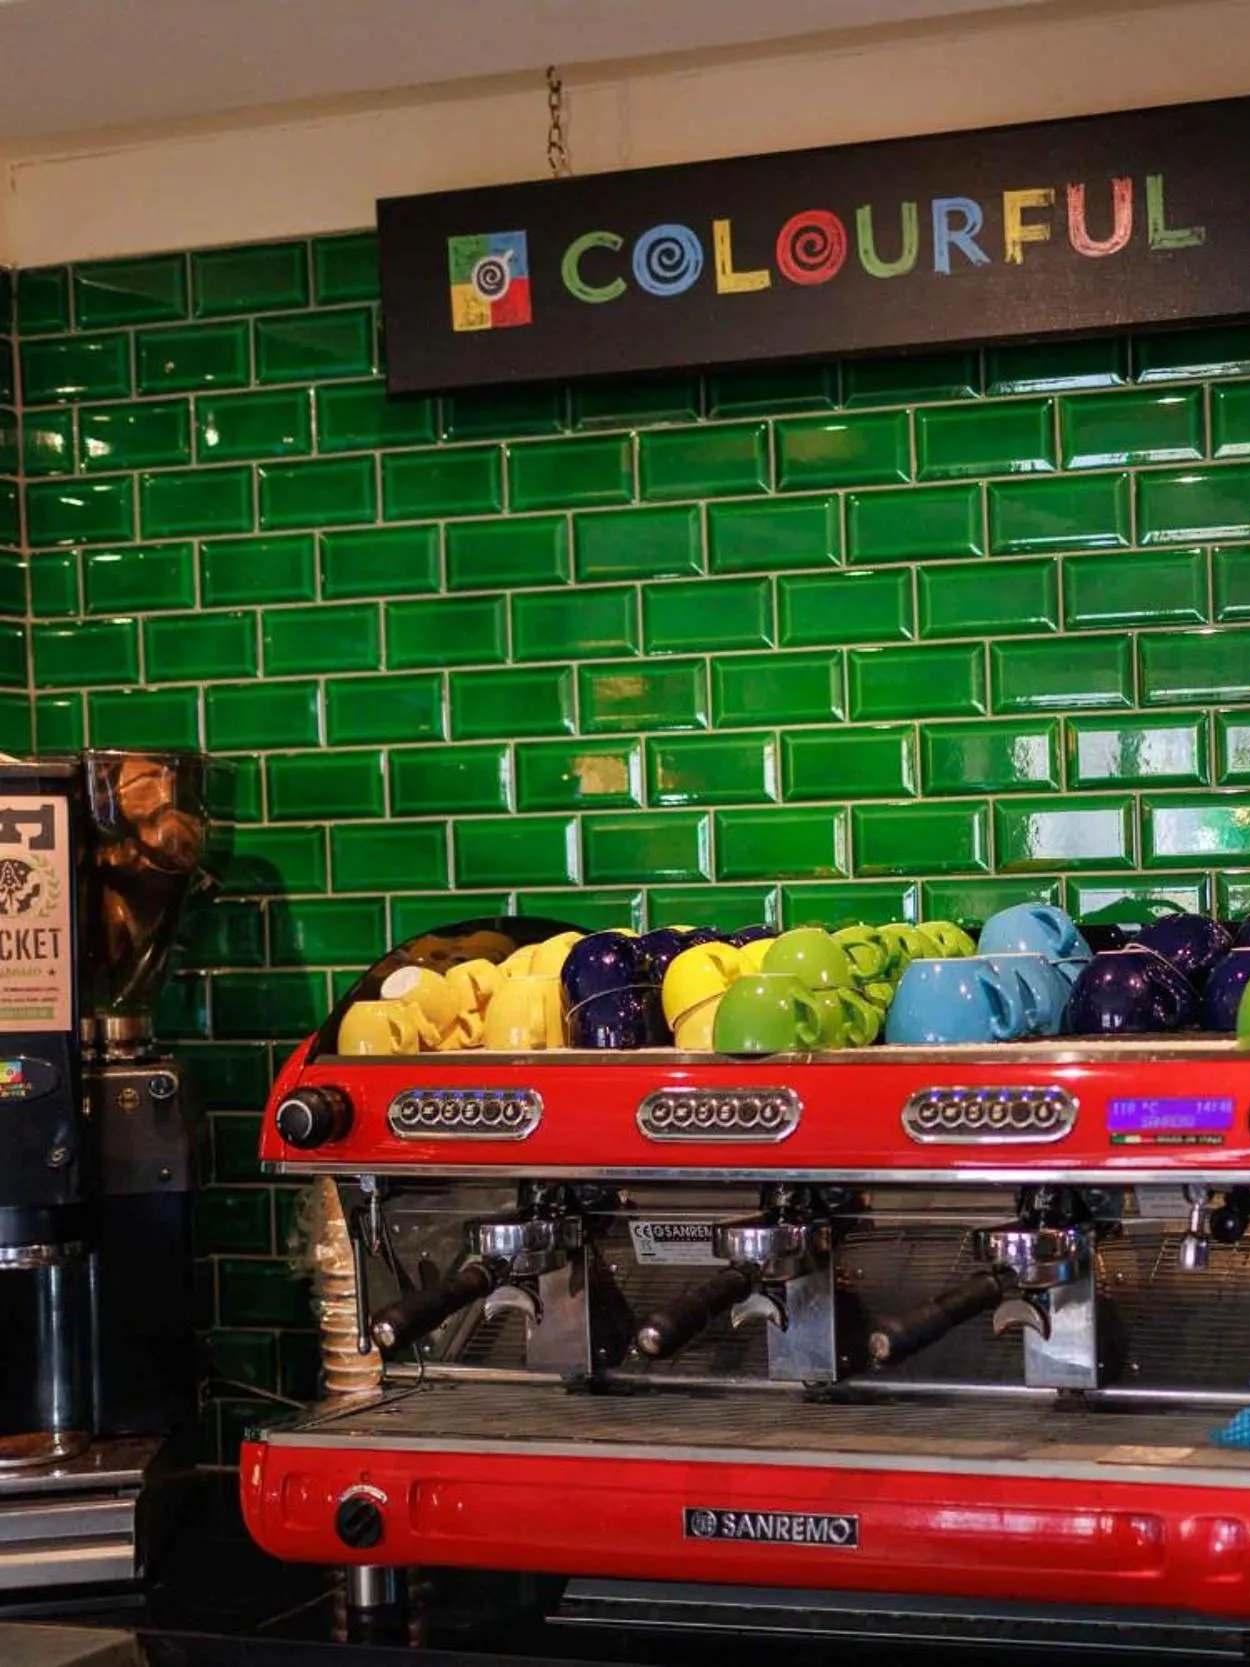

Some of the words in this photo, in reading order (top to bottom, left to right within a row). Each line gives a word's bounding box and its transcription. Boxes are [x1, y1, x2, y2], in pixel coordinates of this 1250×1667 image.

[561, 173, 1206, 303] COLOURFUL
[664, 1226, 713, 1239] SANREM
[721, 1513, 851, 1543] SANREMO
